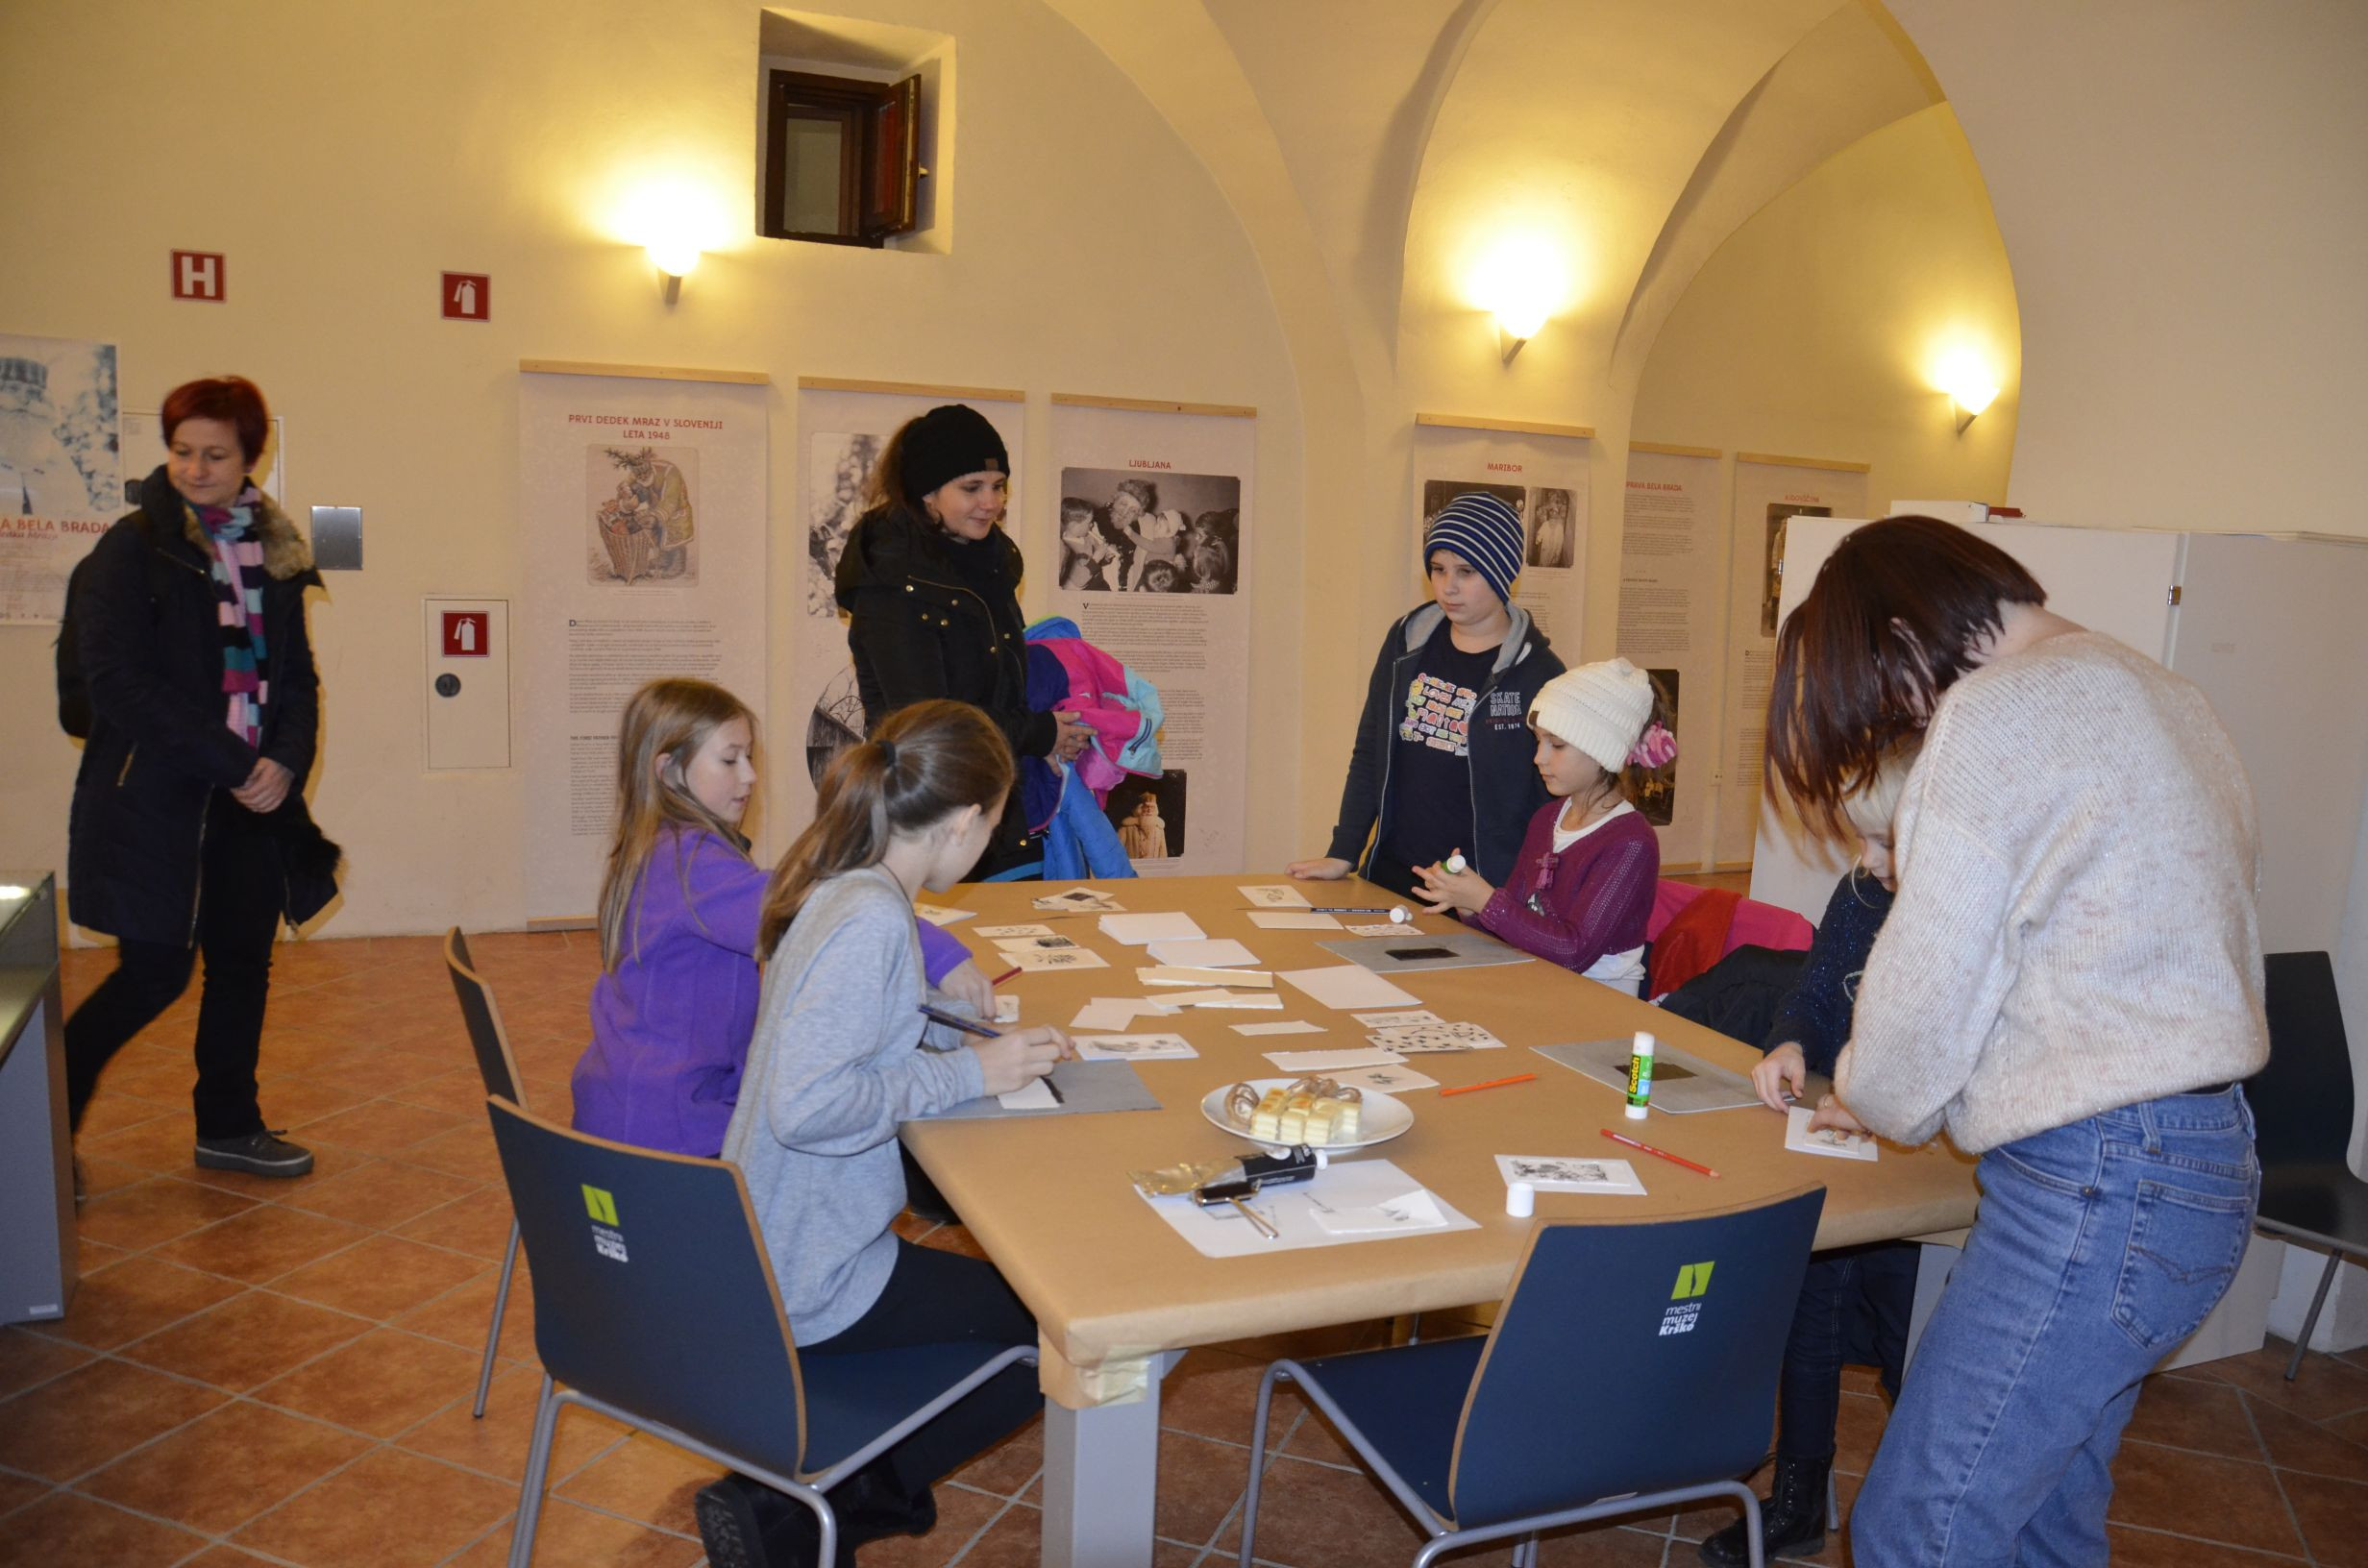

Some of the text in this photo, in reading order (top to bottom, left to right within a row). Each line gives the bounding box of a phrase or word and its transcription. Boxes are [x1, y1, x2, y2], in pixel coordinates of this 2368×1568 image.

[182, 256, 216, 297] H
[568, 414, 723, 429] PRVI DEDEK MRAZ V SLOVENIJI
[623, 429, 670, 440] LETA 1948
[1129, 459, 1172, 470] LJUBLJANA
[1487, 462, 1522, 473] MARIBOR
[17, 519, 55, 531] BELA
[1423, 686, 1452, 704] LOVES
[1491, 692, 1520, 704] SKATE
[1491, 704, 1521, 717] NATION
[1629, 1057, 1640, 1093] Scotch
[1665, 1302, 1702, 1316] mestni
[1663, 1312, 1698, 1326] muzej
